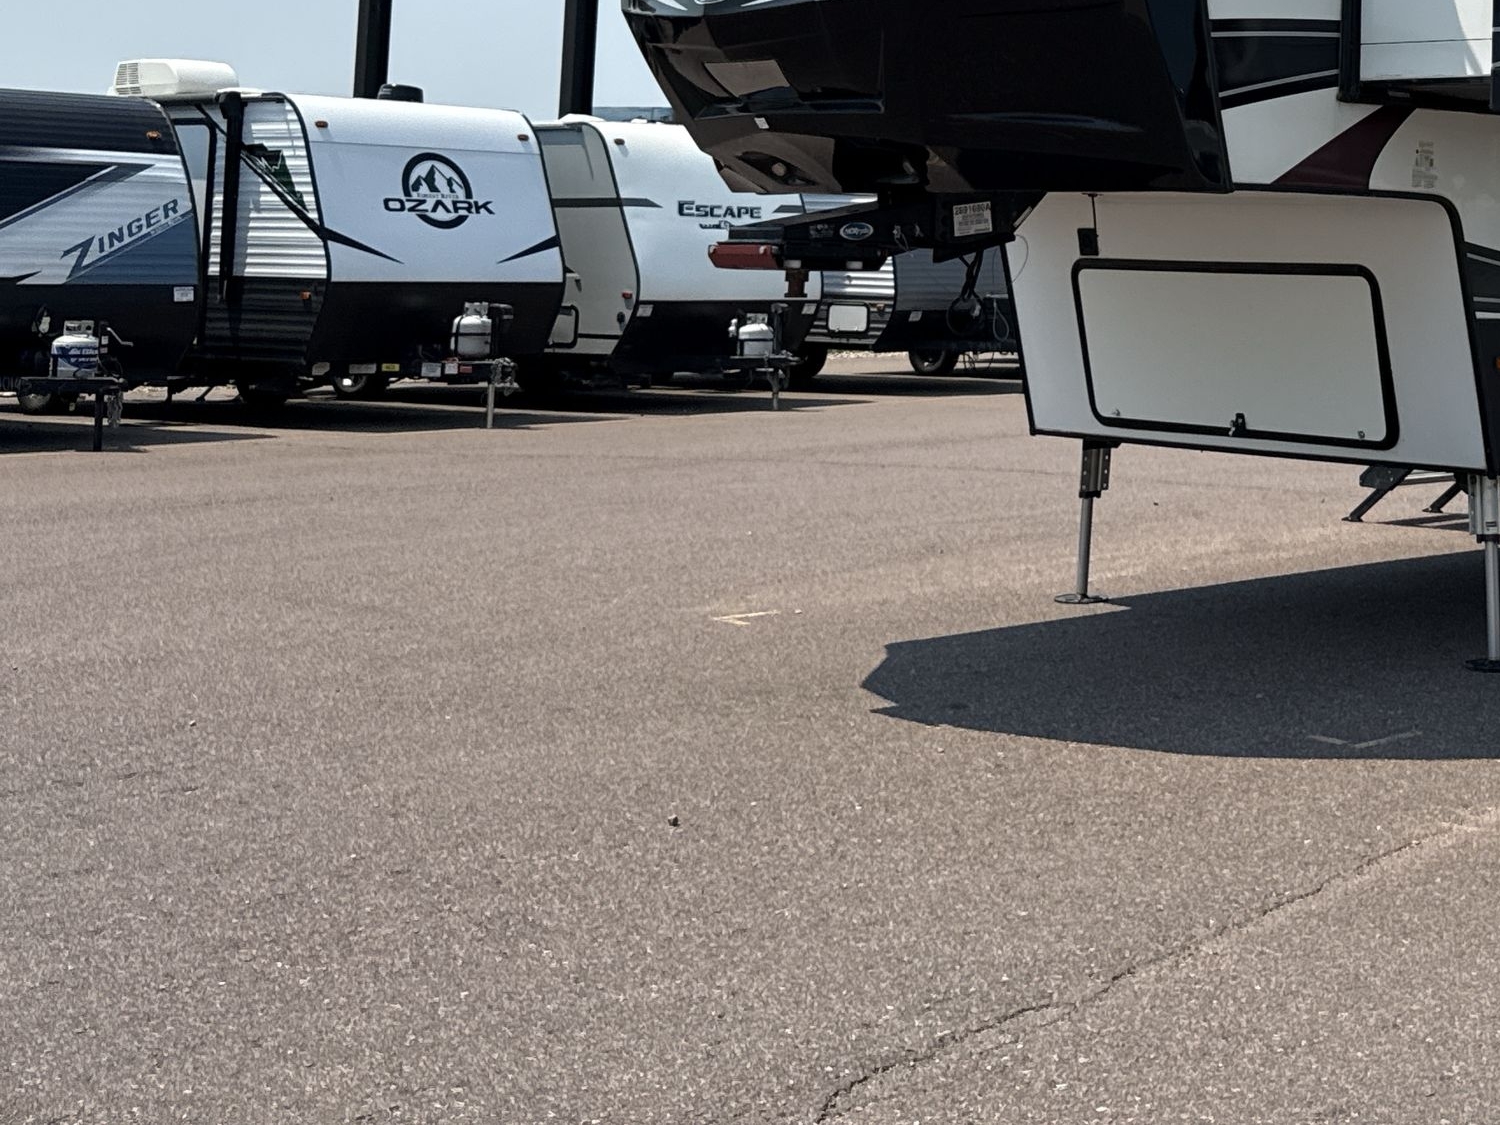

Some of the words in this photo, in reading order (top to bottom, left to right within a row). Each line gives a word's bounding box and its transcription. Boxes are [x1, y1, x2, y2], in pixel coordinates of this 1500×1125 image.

[383, 197, 495, 215] OZARK
[678, 201, 761, 219] ESCAPE
[60, 198, 179, 281] ZINGER
